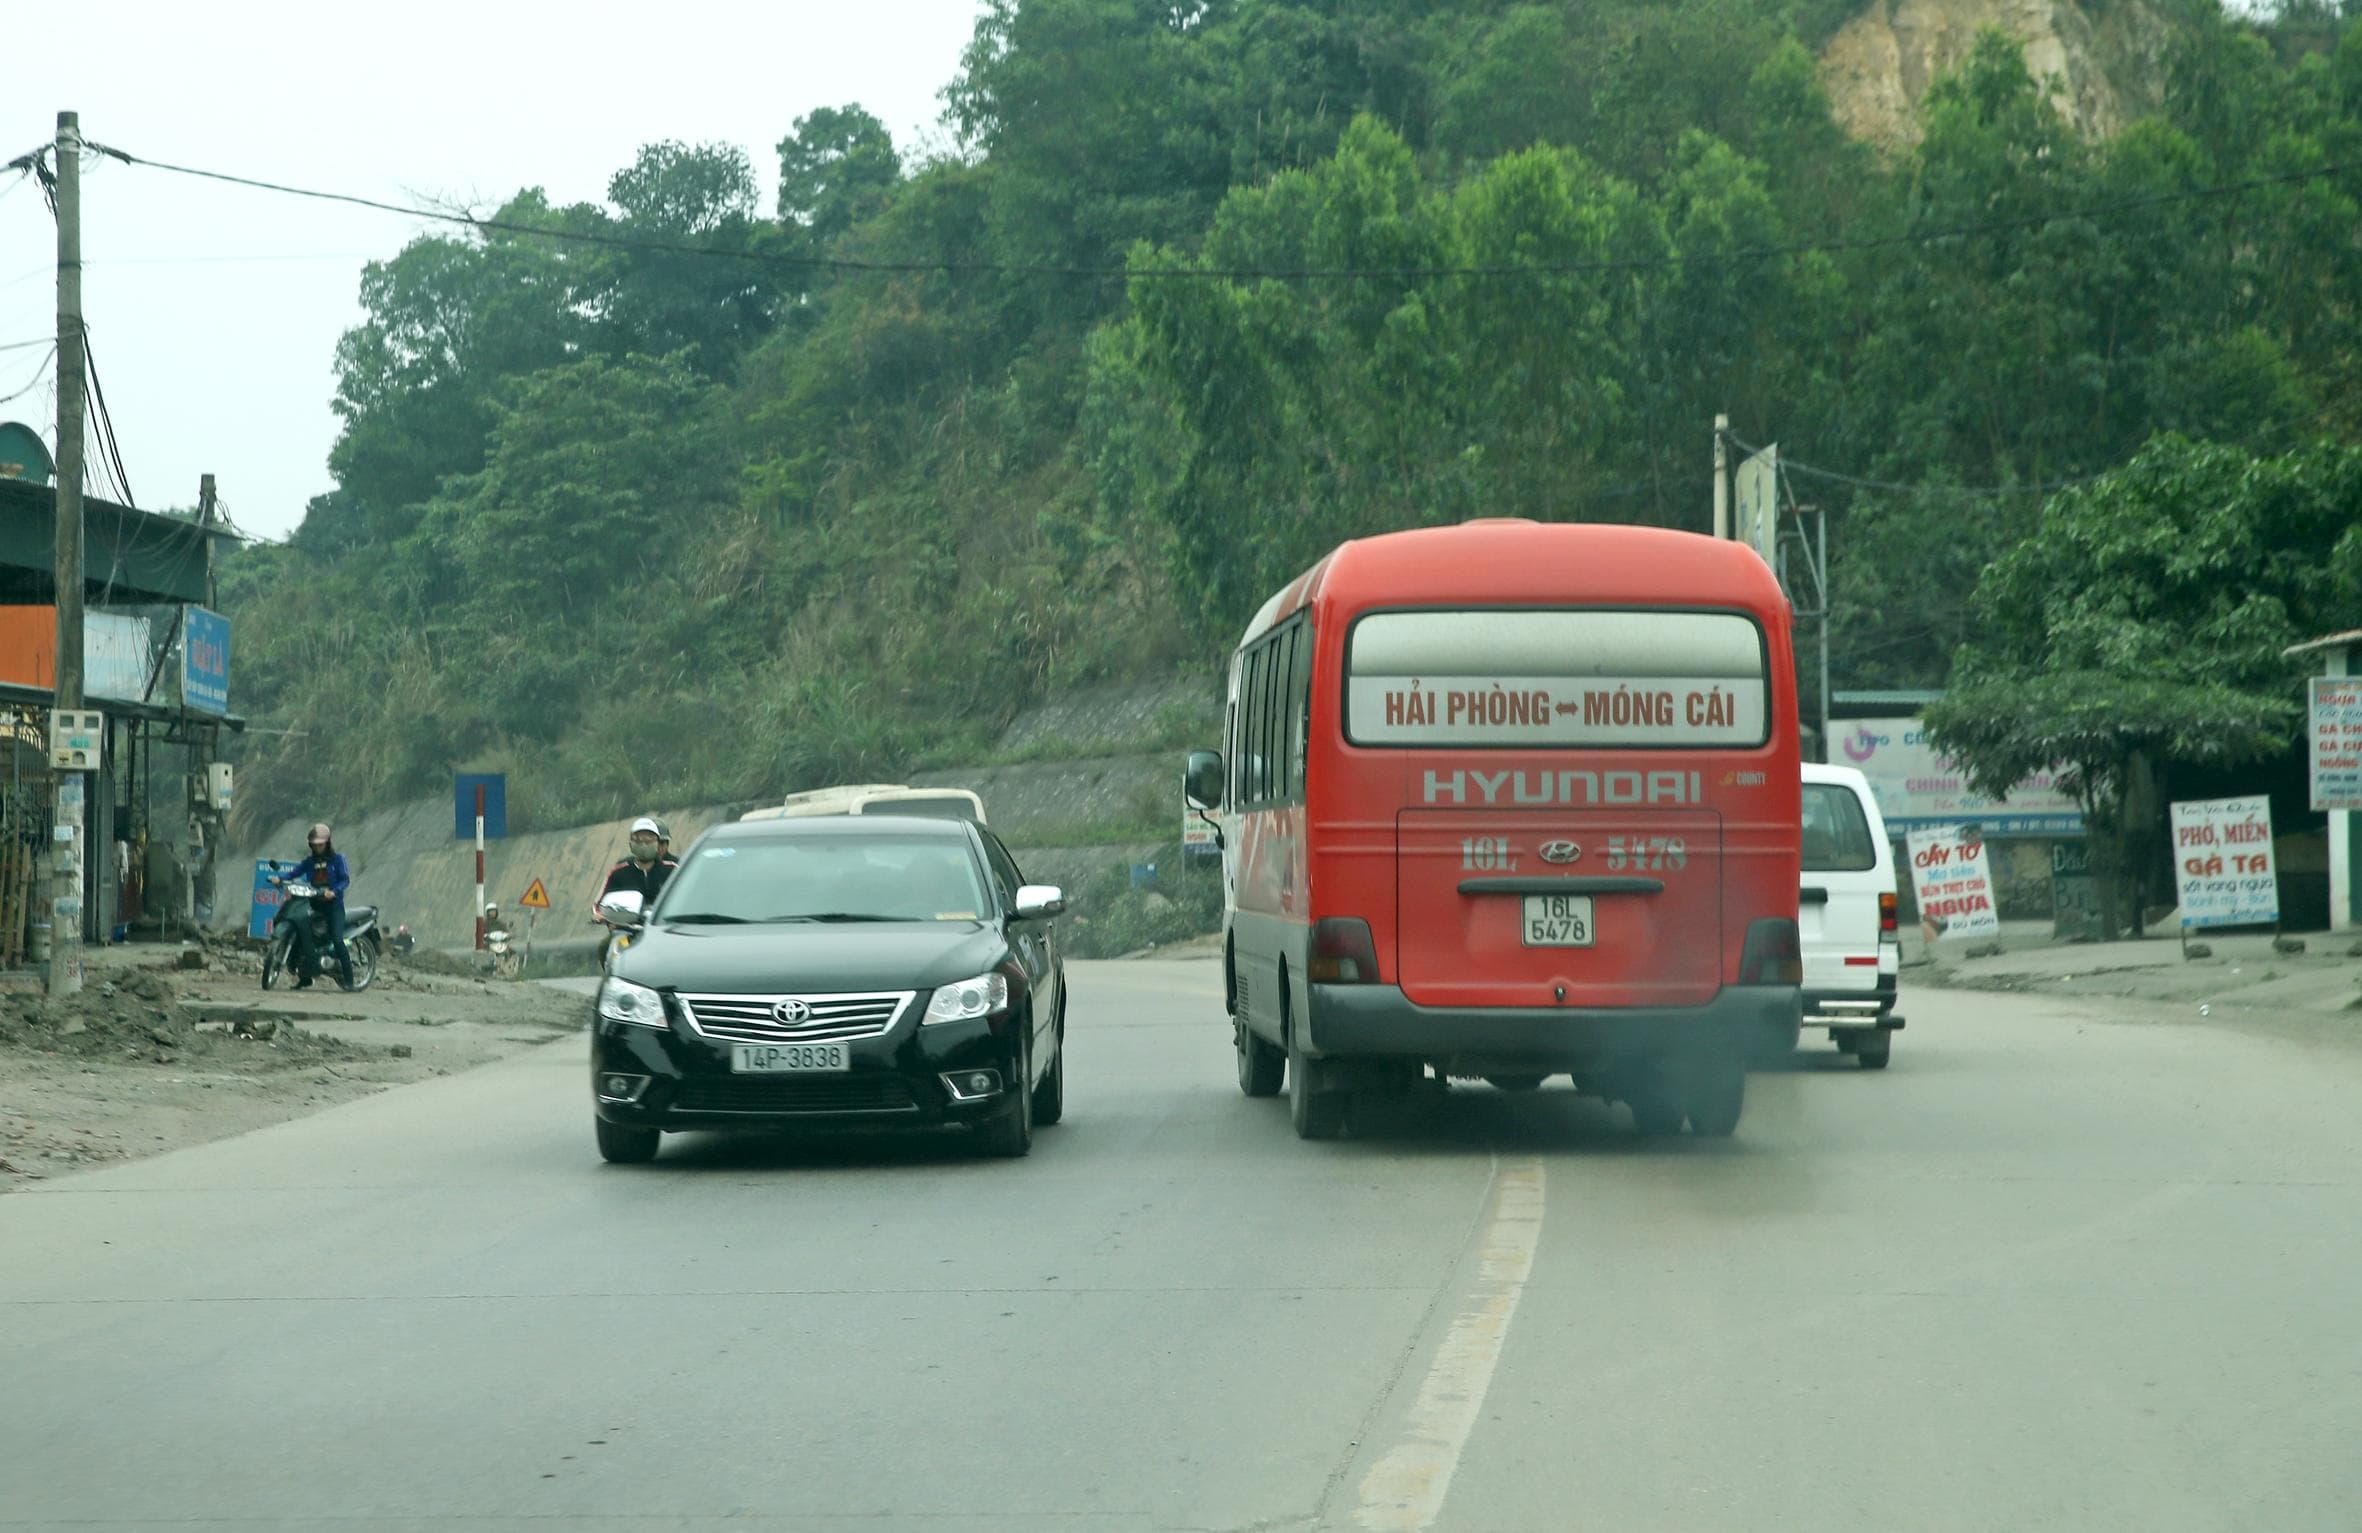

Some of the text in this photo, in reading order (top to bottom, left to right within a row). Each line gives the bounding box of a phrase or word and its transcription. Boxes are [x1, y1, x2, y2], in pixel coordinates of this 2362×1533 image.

[1386, 678, 1735, 727] HẢI PHÒNG MÓNG CÁI
[1423, 769, 1700, 803] HYUNDAI
[1736, 771, 1766, 785] COUNTY
[1459, 835, 1688, 872] 16L 5478
[2185, 853, 2267, 877] GÀ TA
[1540, 896, 1578, 919] 16L
[1531, 920, 1586, 941] 5478
[743, 1047, 841, 1069] 14P-3838
